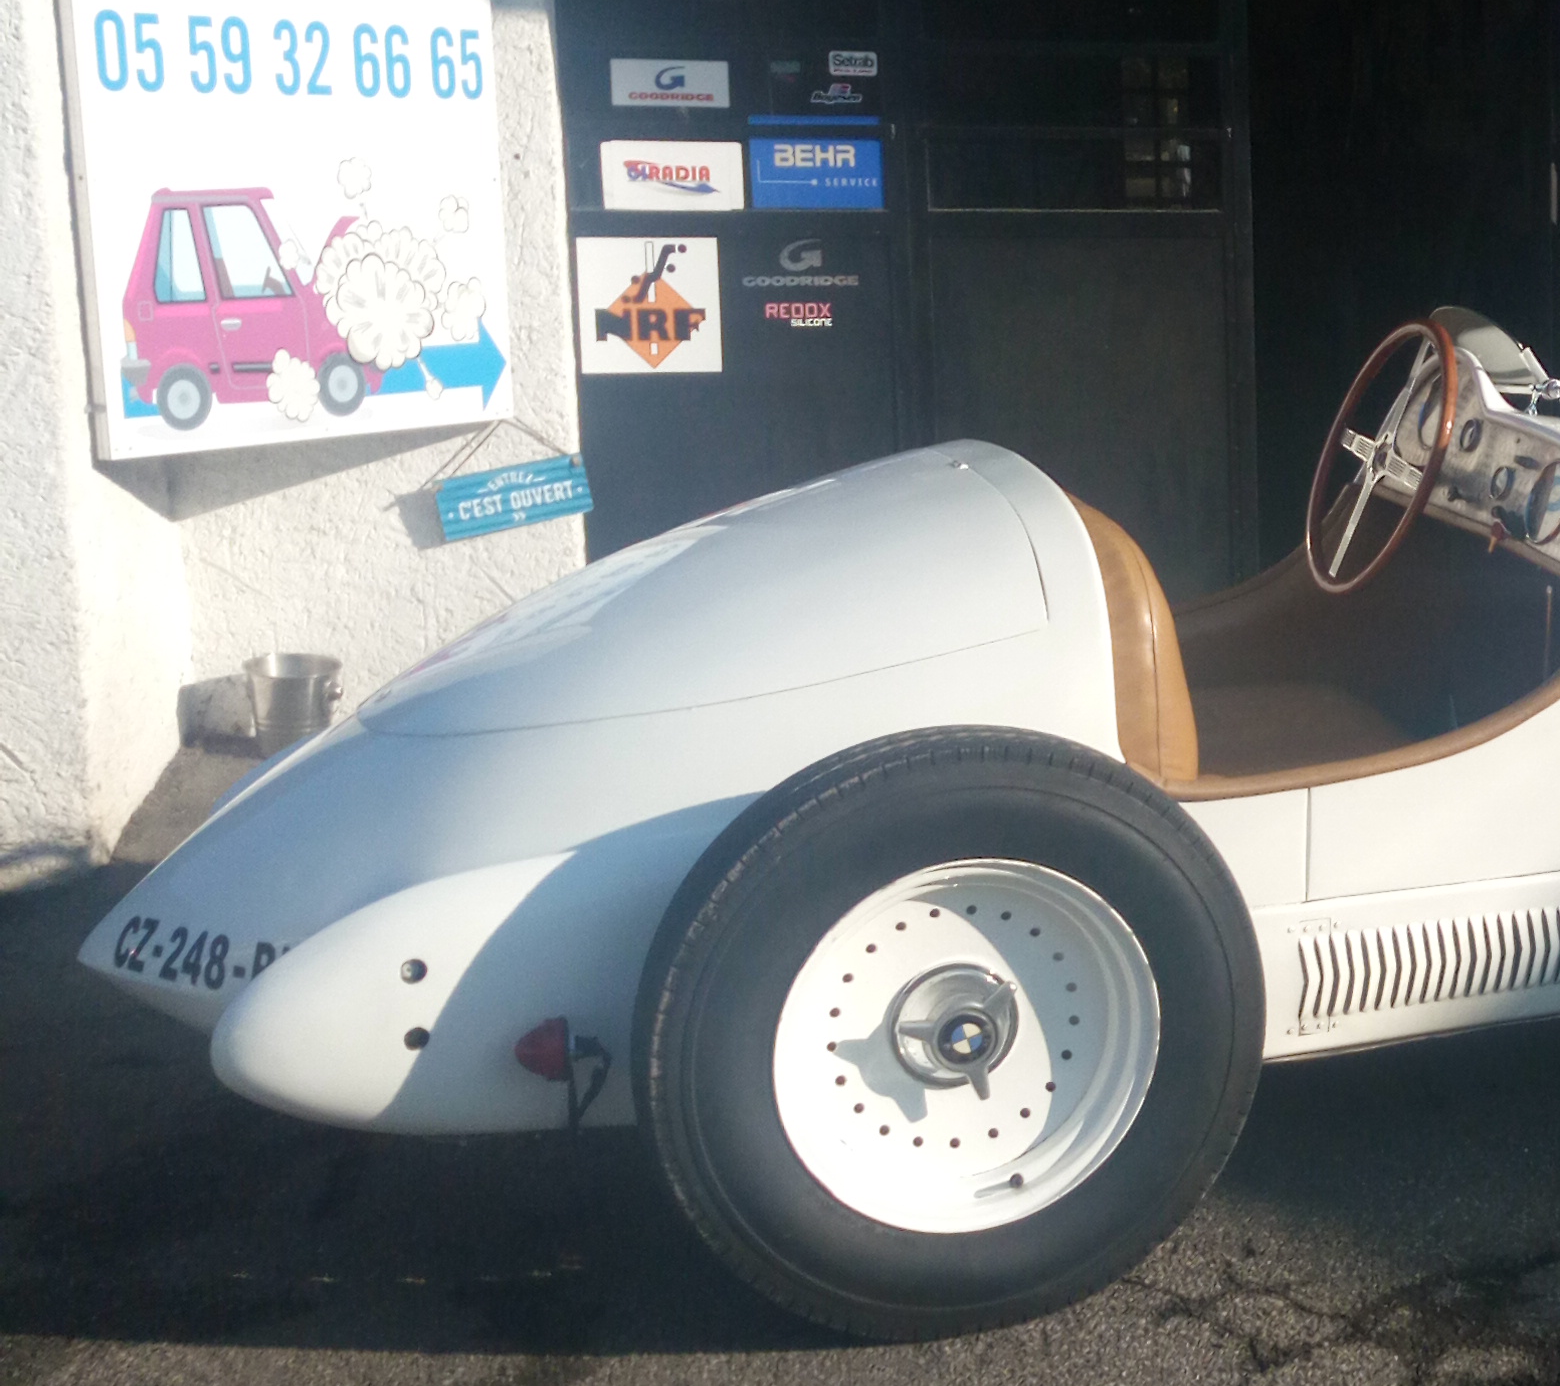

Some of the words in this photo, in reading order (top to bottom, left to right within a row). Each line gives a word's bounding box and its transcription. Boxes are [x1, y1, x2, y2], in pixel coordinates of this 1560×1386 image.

[94, 9, 165, 93] 05
[187, 16, 253, 94] 59
[273, 20, 332, 96] 32
[353, 24, 411, 98] 66
[430, 28, 483, 100] 65
[629, 92, 714, 101] GOODRIDGE
[774, 143, 856, 168] BEHR
[825, 177, 878, 187] SERVICE
[742, 275, 859, 287] GOODRIDGE
[765, 303, 831, 318] REDOX
[595, 308, 706, 341] NRF
[487, 471, 534, 491] ENTREZ
[458, 494, 502, 520] C'EST
[510, 480, 573, 510] OUVERT
